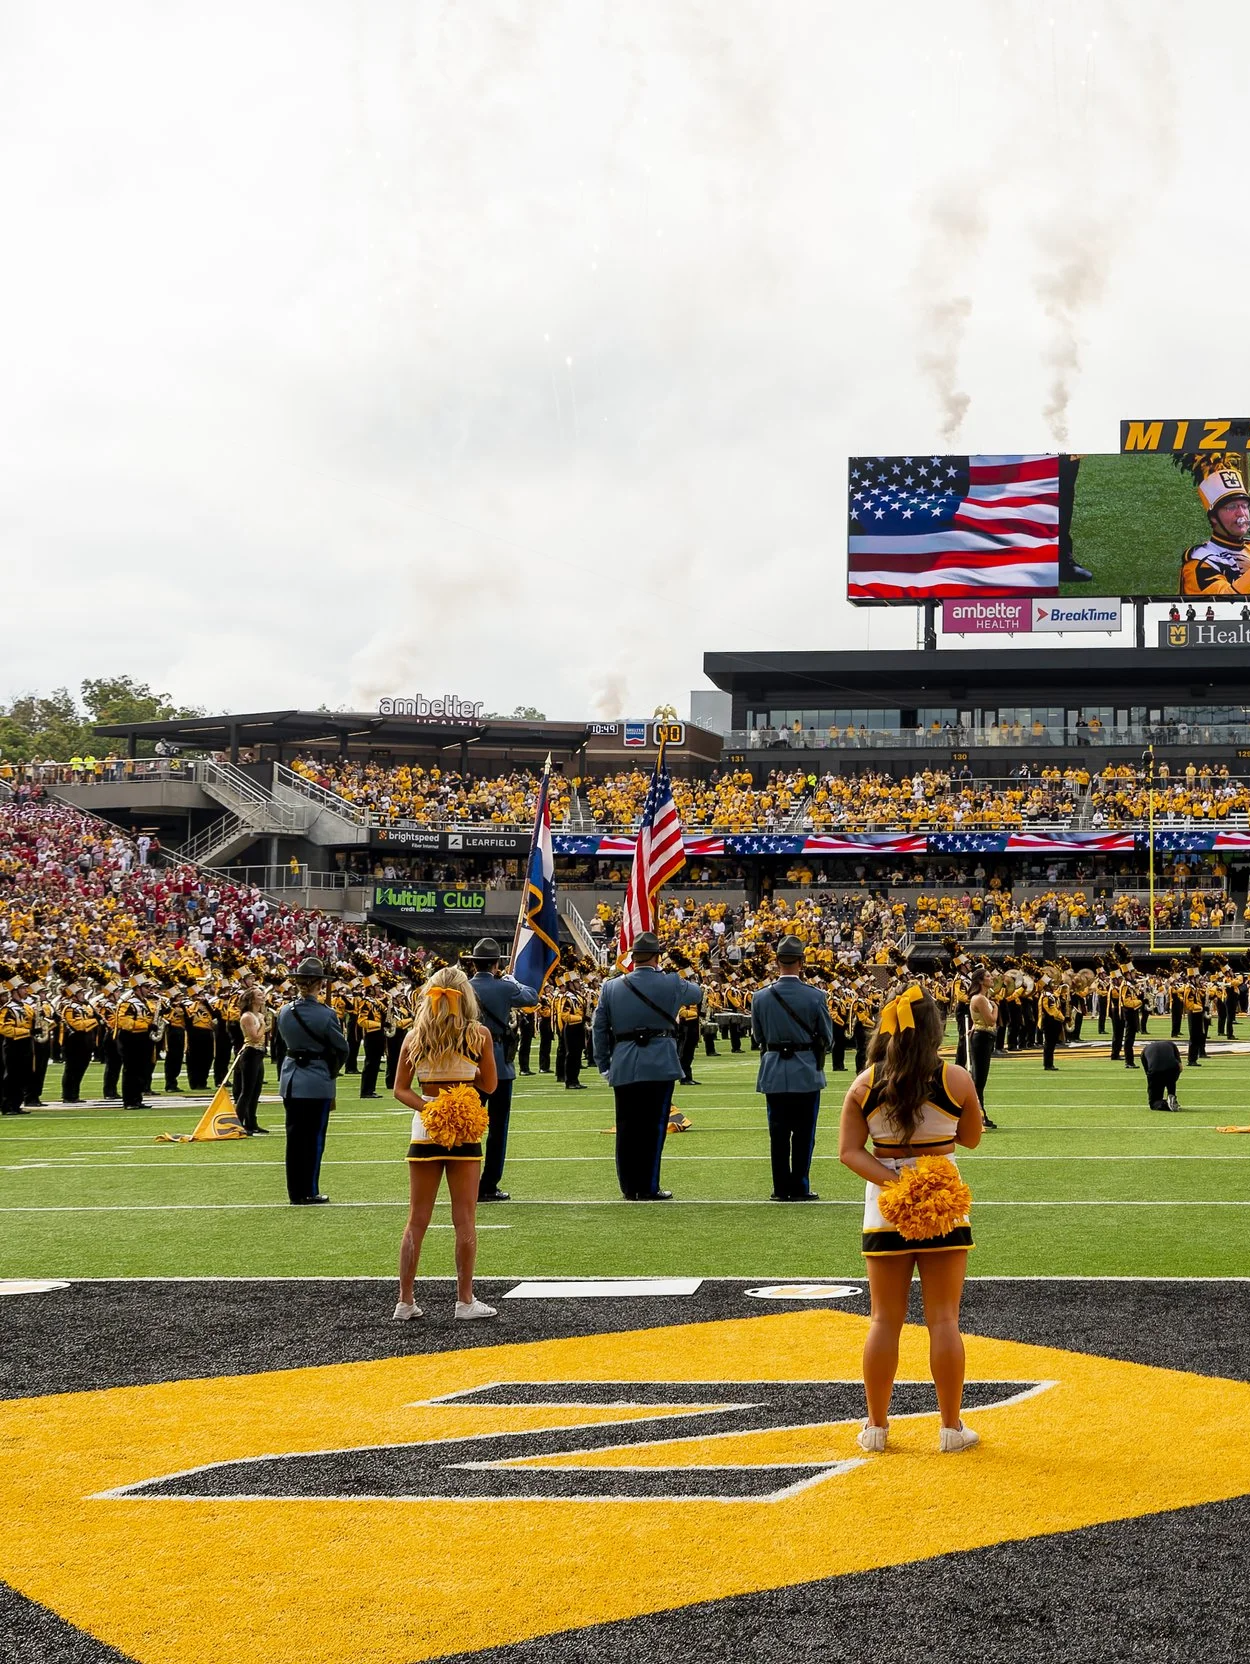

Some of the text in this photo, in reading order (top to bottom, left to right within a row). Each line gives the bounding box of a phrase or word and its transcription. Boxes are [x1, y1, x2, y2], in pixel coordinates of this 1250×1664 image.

[952, 602, 1022, 619] ambetter
[1050, 608, 1117, 621] BreakTime
[976, 620, 1020, 629] HEALTH
[380, 694, 484, 718] ambetter
[592, 725, 615, 734] 10:49
[389, 831, 439, 843] brightspeed
[466, 838, 516, 847] LEARFIELD
[376, 887, 484, 912] Multipli Club
